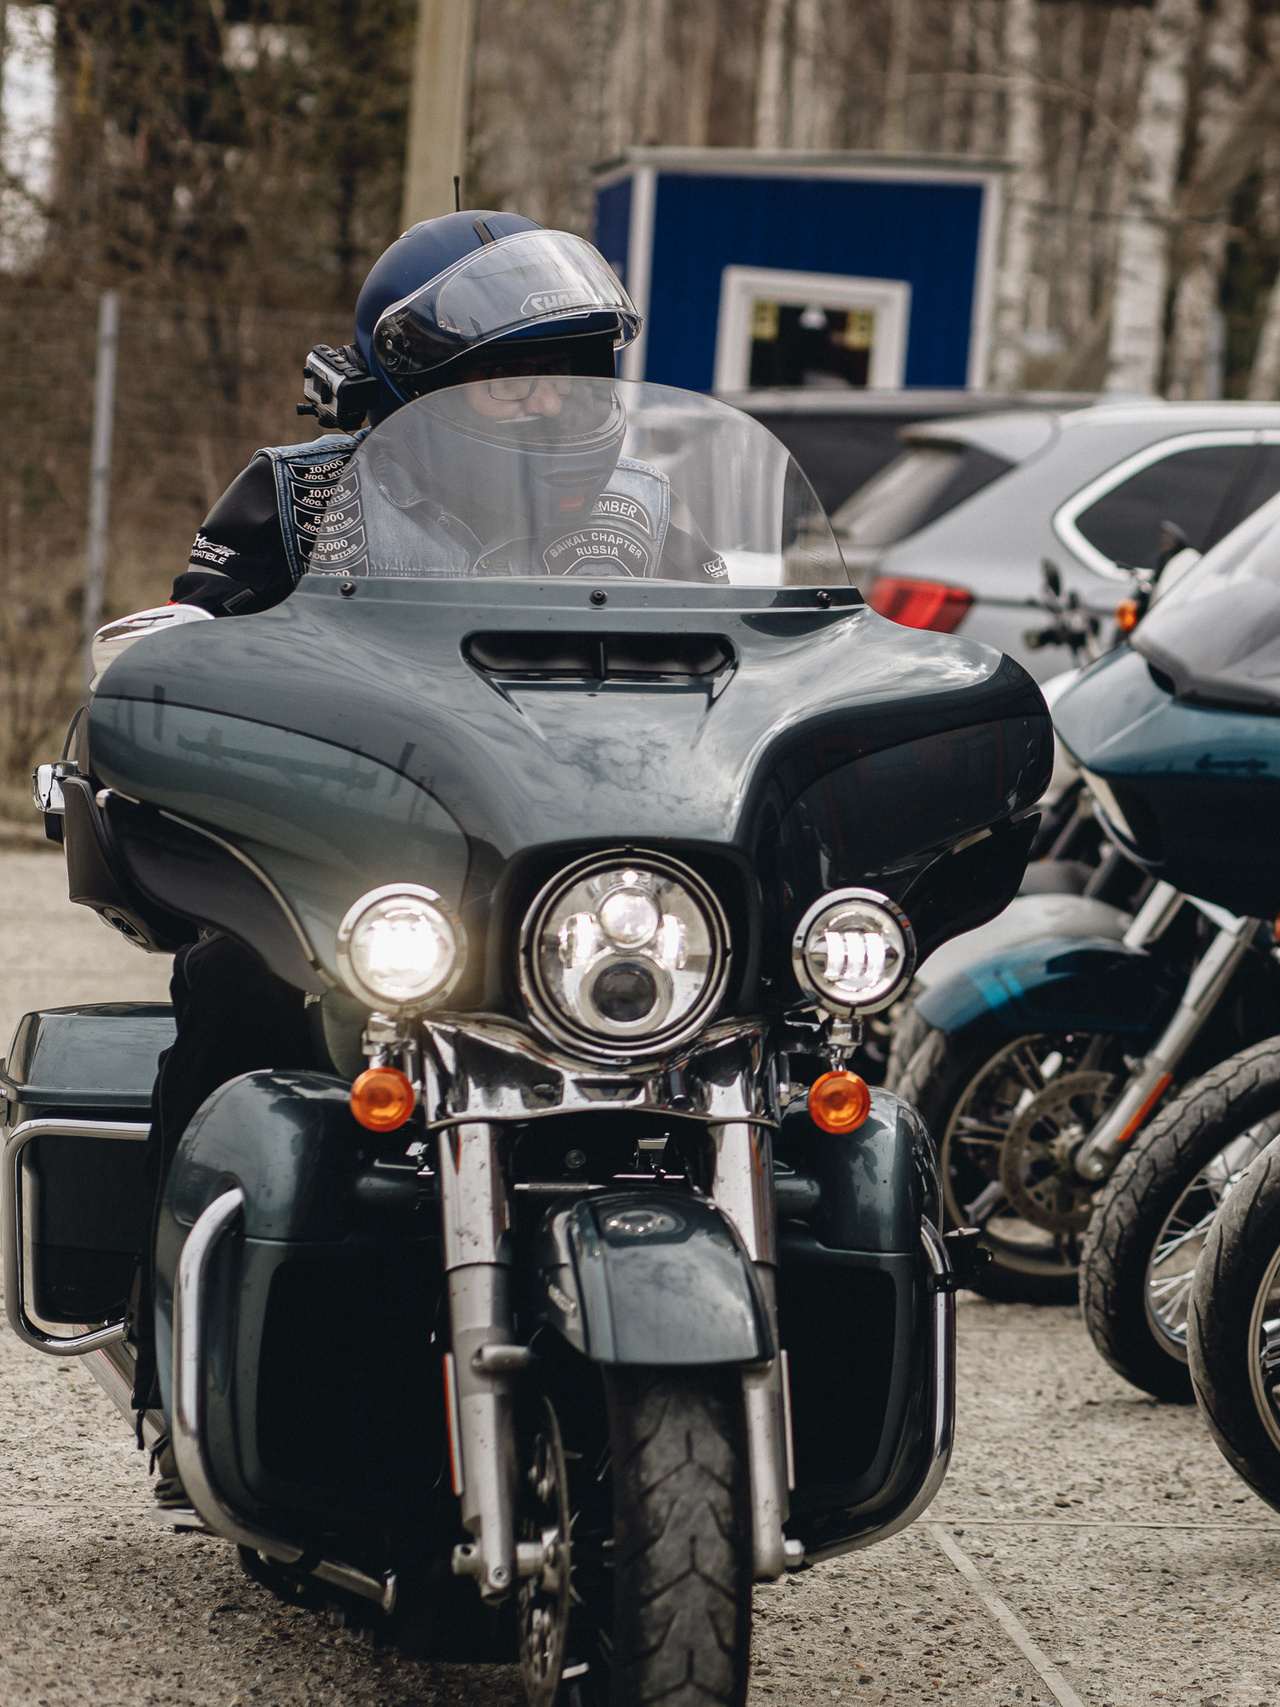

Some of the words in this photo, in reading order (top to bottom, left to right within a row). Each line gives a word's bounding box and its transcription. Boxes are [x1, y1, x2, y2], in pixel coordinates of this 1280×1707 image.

[309, 460, 344, 474] 10,000
[301, 496, 323, 507] HOG.
[326, 489, 352, 506] MILES
[308, 484, 344, 499] 10,000
[596, 500, 638, 518] MBER
[326, 516, 354, 532] MILES
[317, 539, 348, 553] 5,000
[330, 543, 358, 561] MILES
[549, 533, 589, 558] BAIKAL
[591, 532, 643, 559] CHAPTER
[576, 544, 619, 557] RUSSIA
